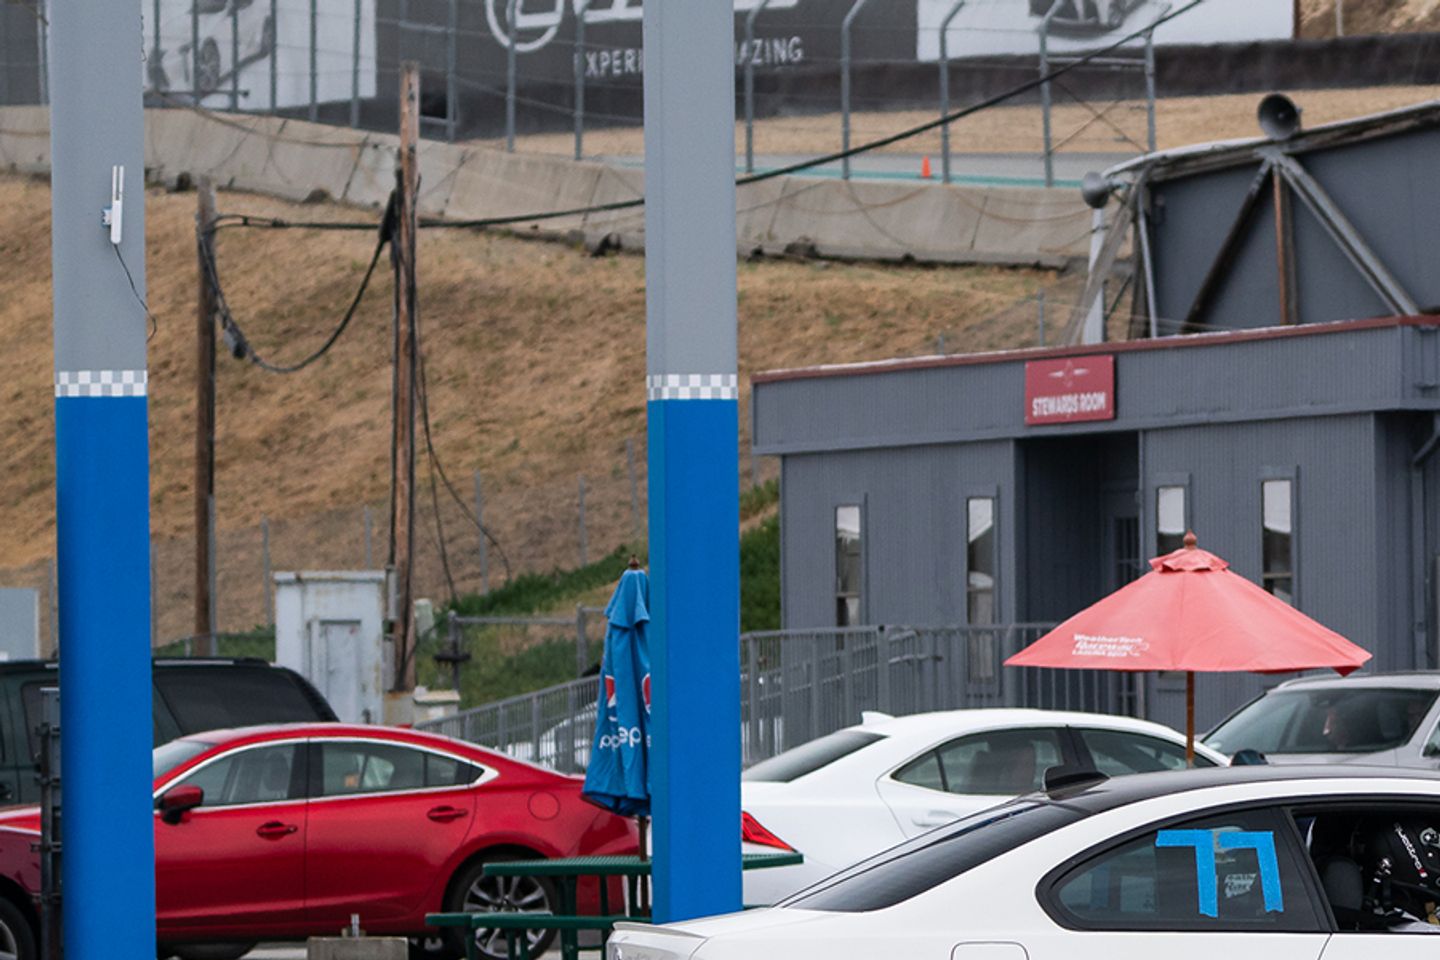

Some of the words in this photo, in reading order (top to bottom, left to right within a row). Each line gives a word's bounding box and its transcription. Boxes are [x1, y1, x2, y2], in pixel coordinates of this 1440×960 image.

[574, 48, 644, 77] XPERI
[734, 36, 803, 66] AZING
[1032, 394, 1078, 417] STEWARDS
[1080, 391, 1106, 412] ROOM
[1155, 828, 1284, 918] 77
